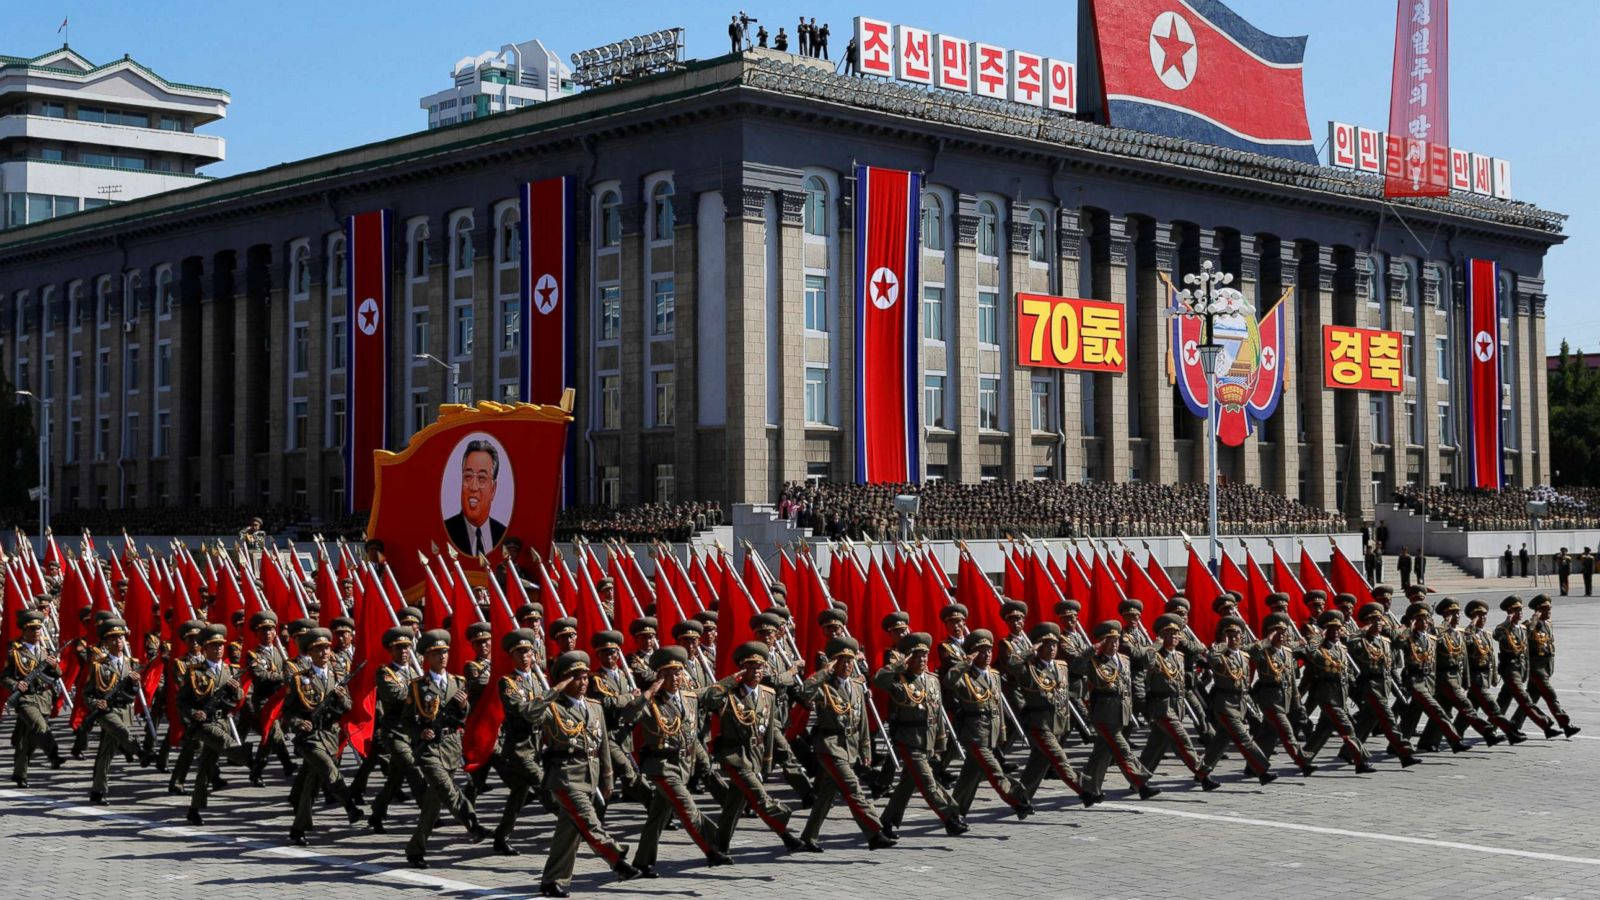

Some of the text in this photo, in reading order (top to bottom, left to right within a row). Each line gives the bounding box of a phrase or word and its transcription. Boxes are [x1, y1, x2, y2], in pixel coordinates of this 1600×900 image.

[864, 22, 1074, 109] 조선민주주의
[1023, 299, 1123, 366] 70돐
[1330, 330, 1401, 388] 경축
